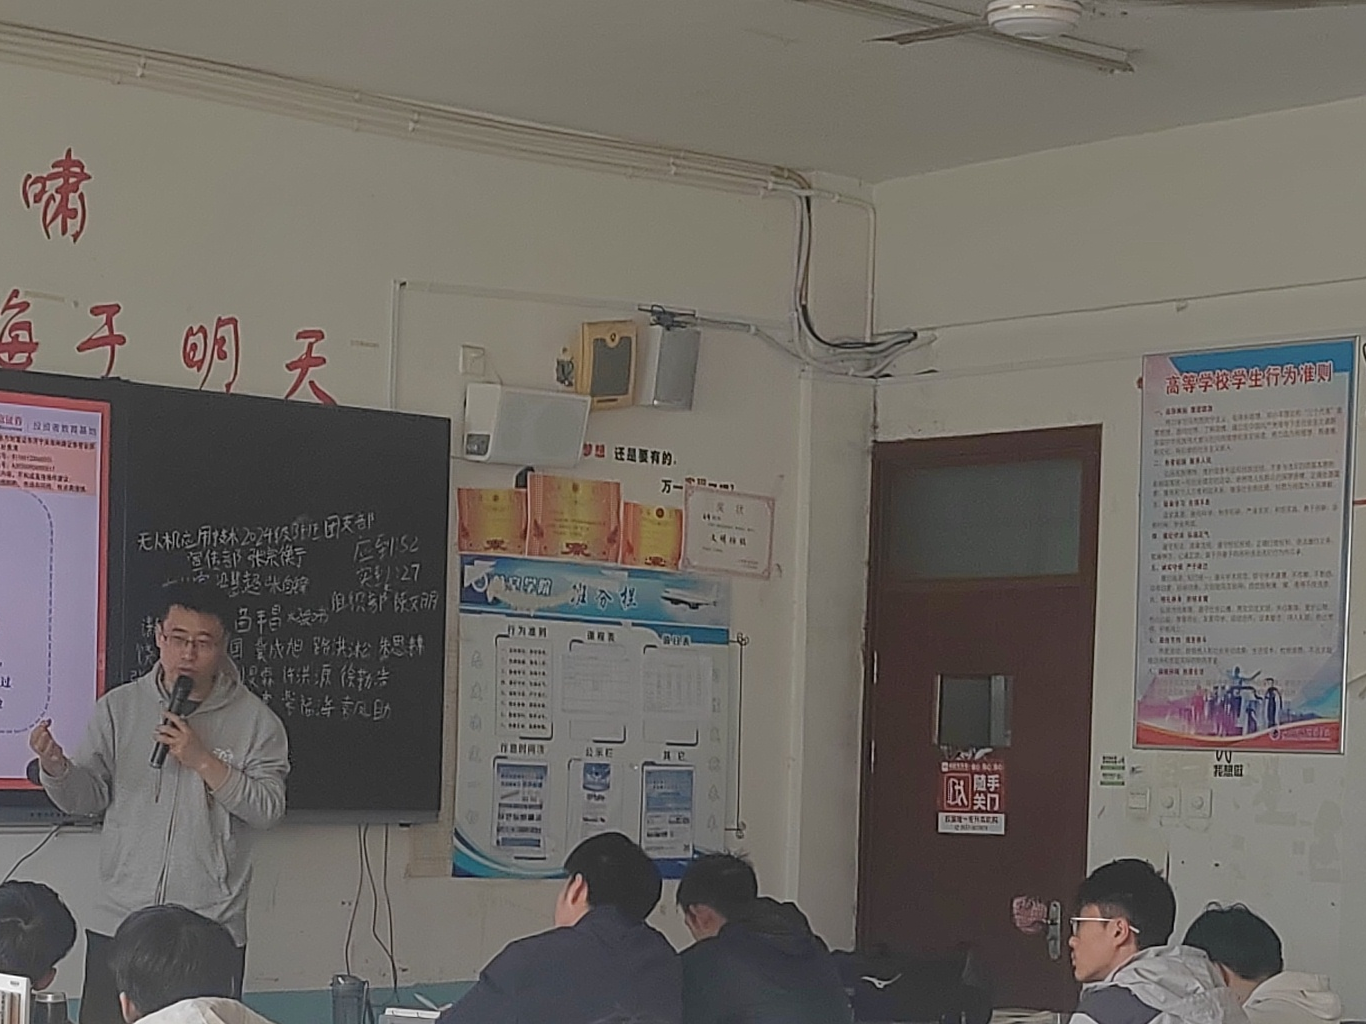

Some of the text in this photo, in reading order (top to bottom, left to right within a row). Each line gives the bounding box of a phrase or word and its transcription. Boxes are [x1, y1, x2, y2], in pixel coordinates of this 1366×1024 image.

[1166, 361, 1333, 395] 高等学校学生行为准则
[973, 793, 999, 811] 关门
